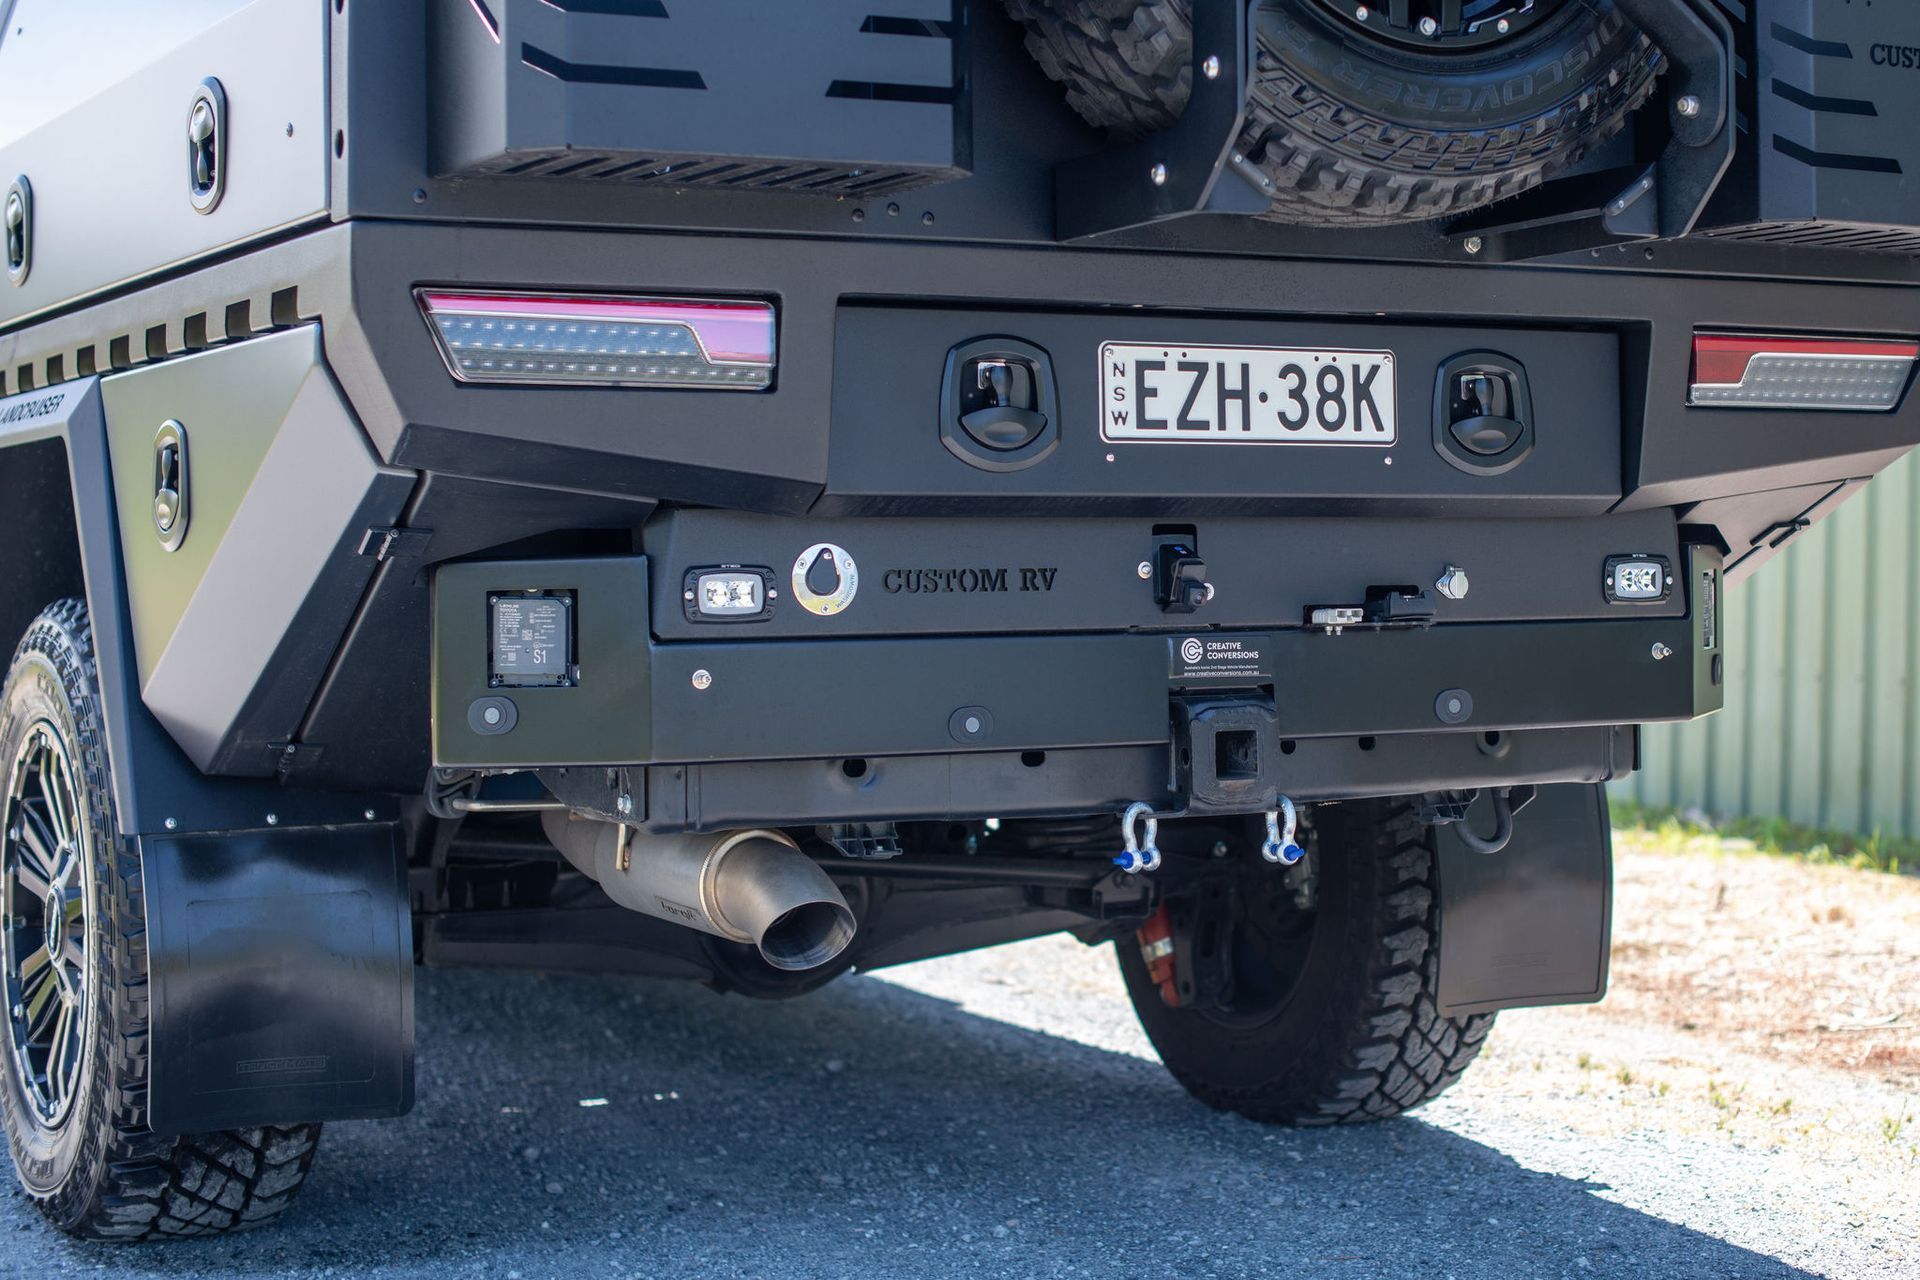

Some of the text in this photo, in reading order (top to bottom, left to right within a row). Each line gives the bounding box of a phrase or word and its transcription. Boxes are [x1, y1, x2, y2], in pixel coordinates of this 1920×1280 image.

[1111, 362, 1128, 426] NSW
[881, 567, 1058, 594] CUSTOM RV
[1206, 642, 1242, 650] CREATIVE
[533, 649, 546, 664] S1
[1206, 651, 1259, 659] CONVERSIONS
